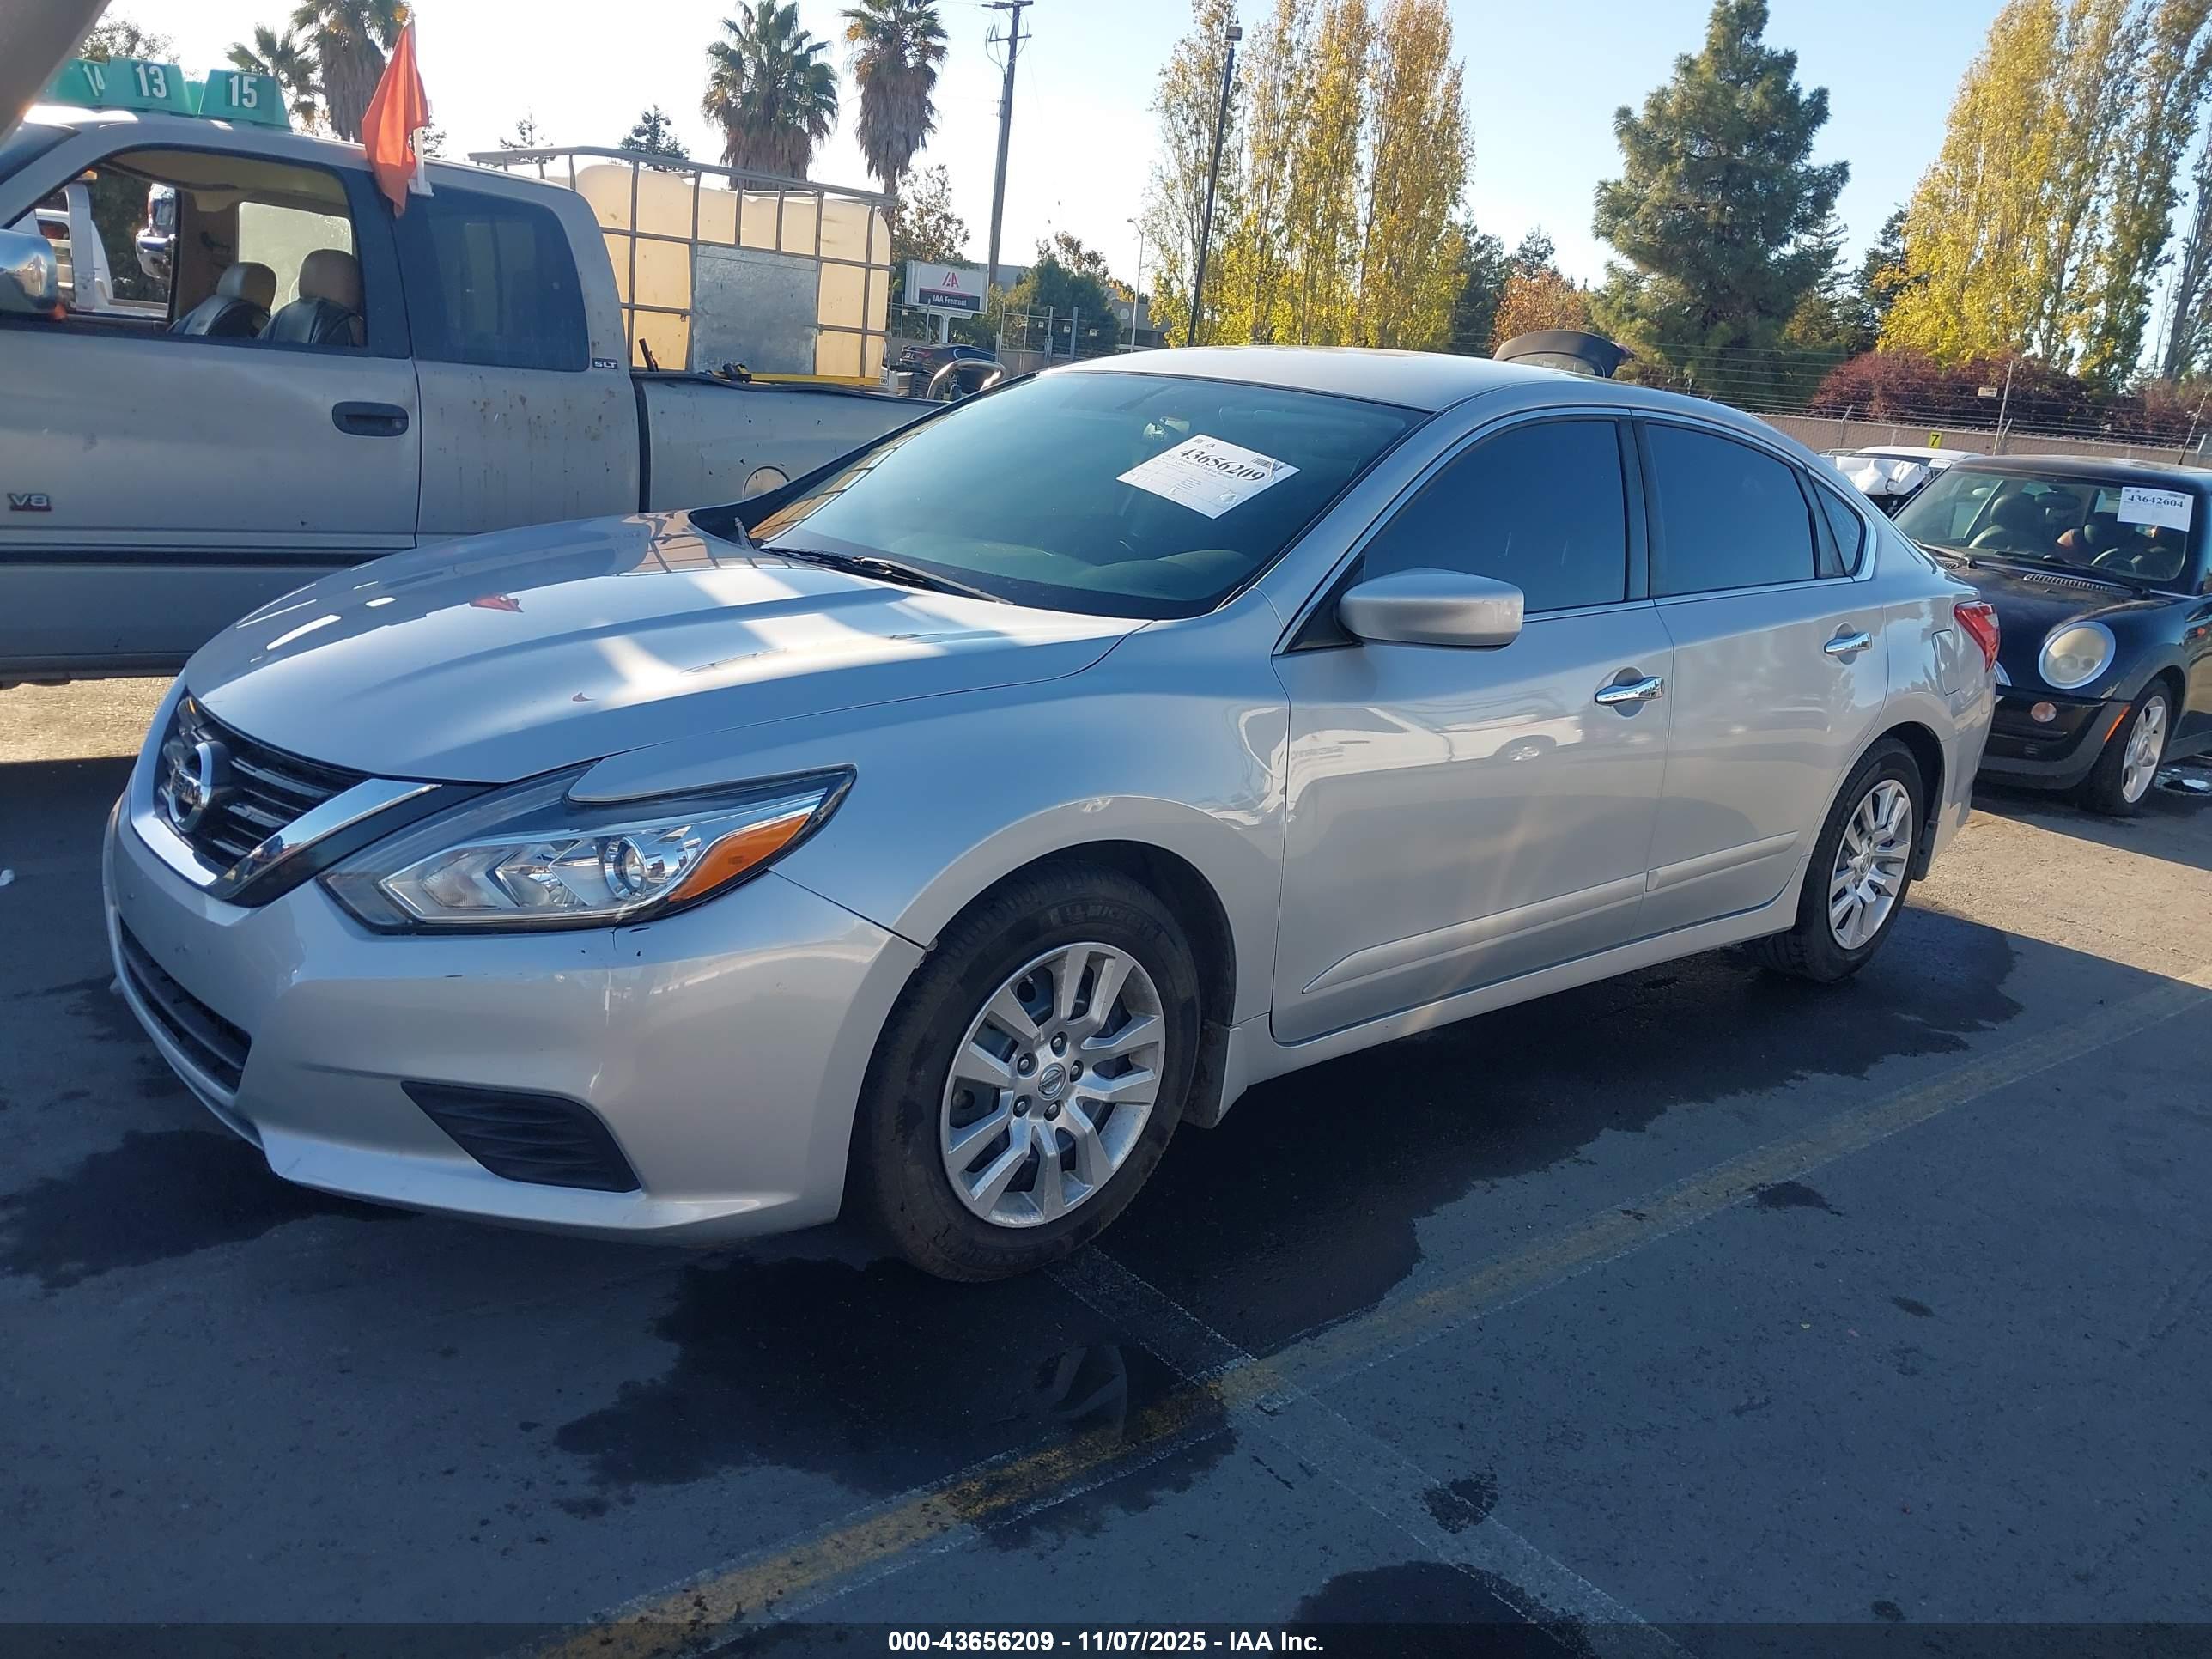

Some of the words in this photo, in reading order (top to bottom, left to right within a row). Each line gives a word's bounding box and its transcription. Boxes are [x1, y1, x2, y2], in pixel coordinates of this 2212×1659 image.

[135, 64, 167, 99] 13
[228, 75, 258, 108] 15
[933, 295, 945, 304] IAA
[945, 296, 967, 307] Fremont
[594, 360, 617, 368] SLT
[1931, 434, 1940, 447] 7
[1179, 447, 1266, 482] 43656209
[9, 494, 50, 507] V8
[2128, 495, 2184, 508] 43642604
